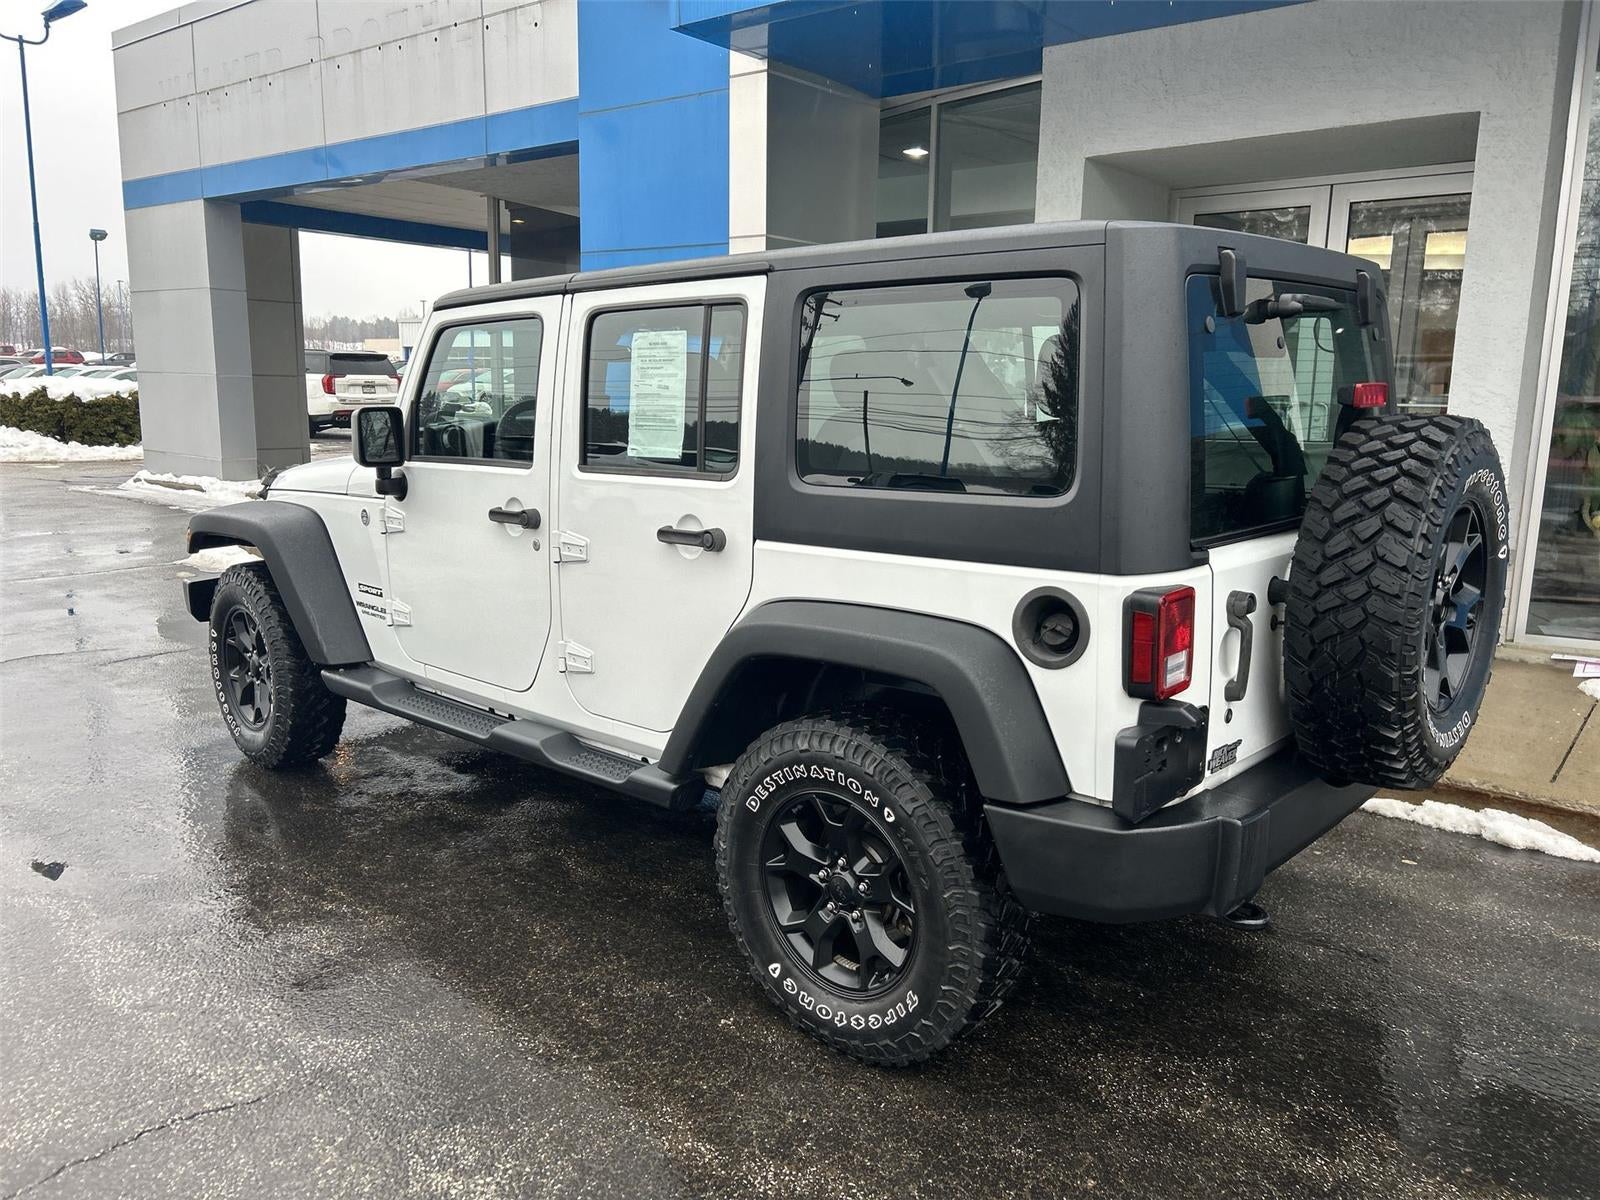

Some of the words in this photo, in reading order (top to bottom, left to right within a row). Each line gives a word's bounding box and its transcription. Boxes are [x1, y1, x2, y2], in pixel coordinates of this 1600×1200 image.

[1462, 469, 1507, 541] Firestone
[356, 600, 386, 614] WRANGLER
[358, 583, 383, 597] SPORT
[745, 763, 880, 813] DESTINATION
[782, 977, 920, 1031] Firestone
